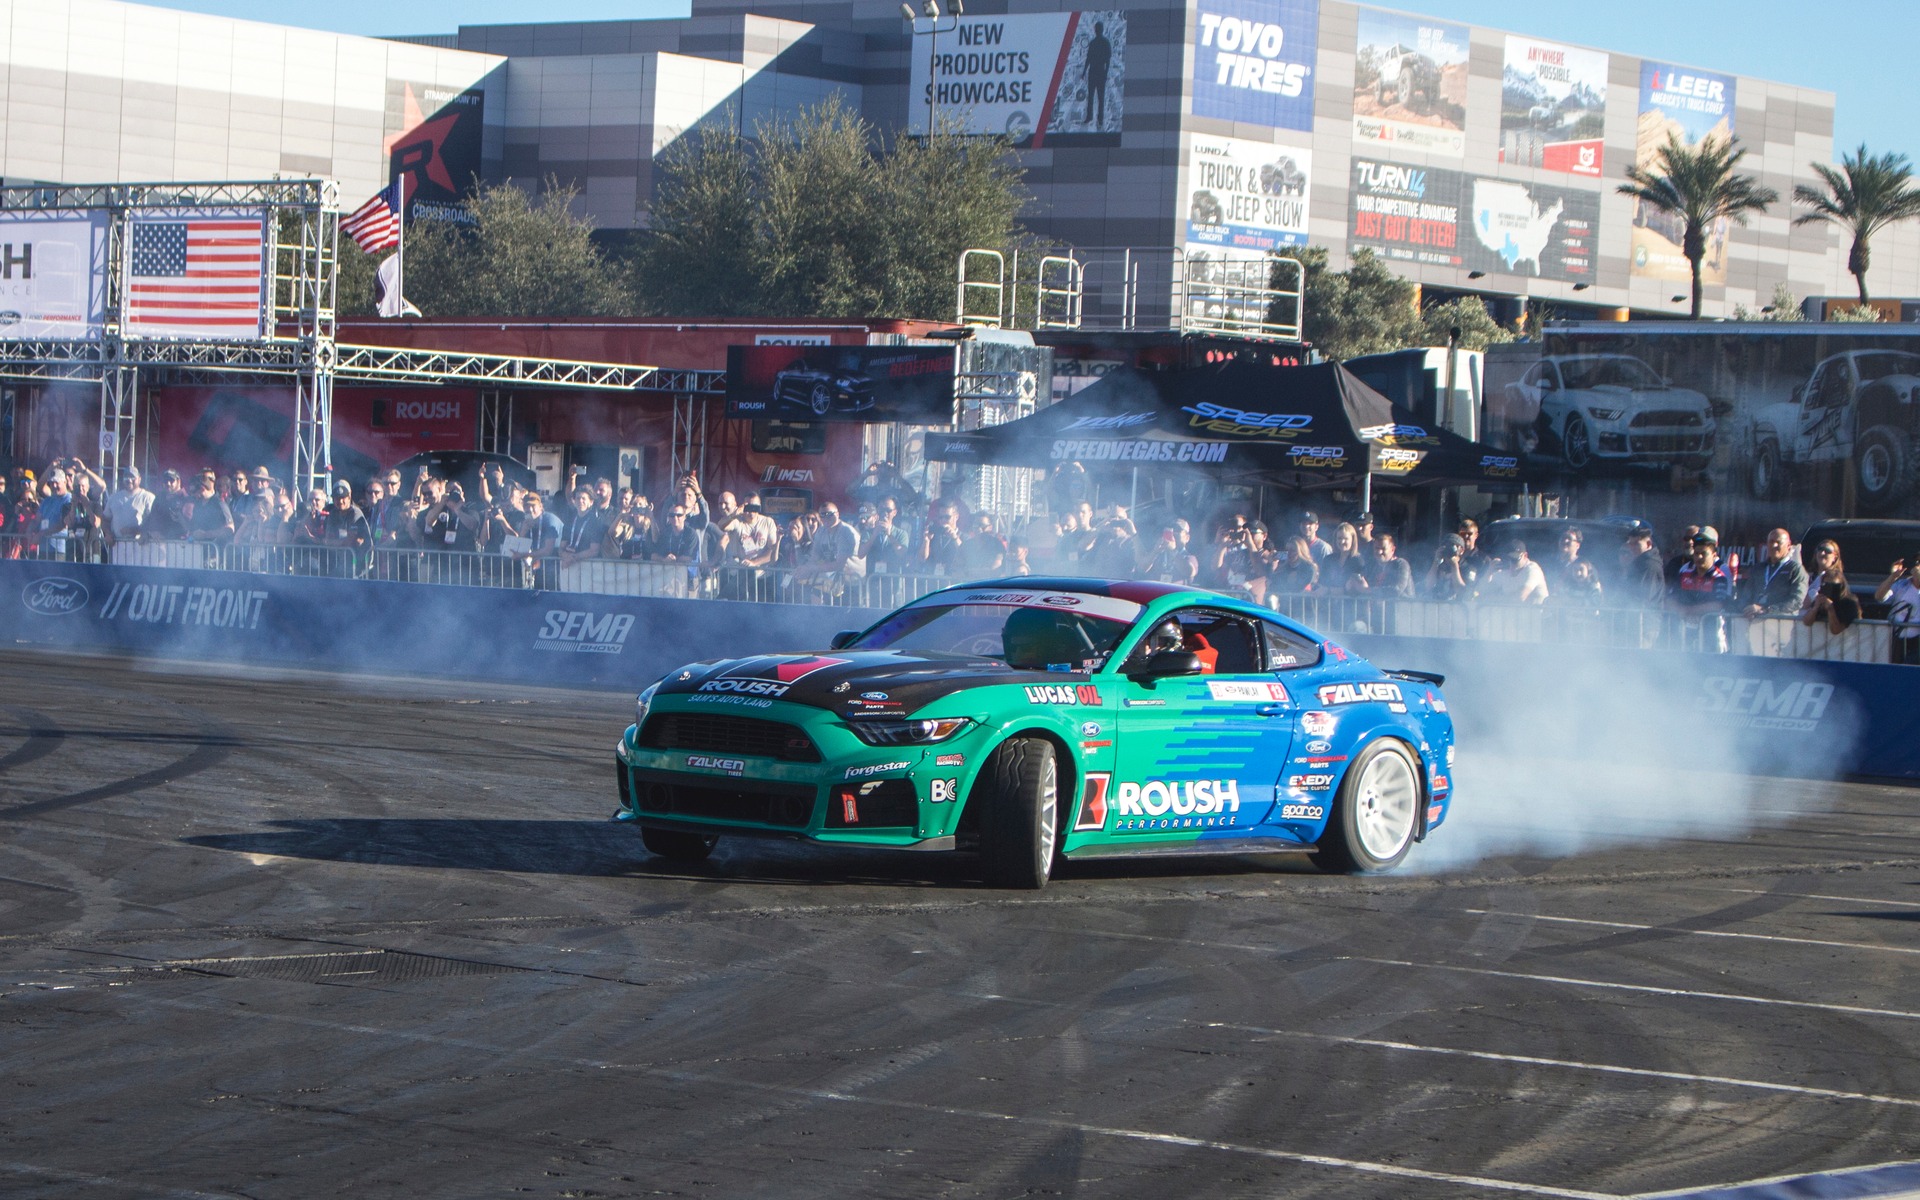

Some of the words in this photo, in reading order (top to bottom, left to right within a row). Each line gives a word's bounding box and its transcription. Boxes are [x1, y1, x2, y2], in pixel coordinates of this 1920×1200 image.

[958, 23, 1004, 46] NEW
[1200, 13, 1284, 59] TOYO
[930, 52, 1030, 76] PRODUCTS
[1528, 46, 1565, 66] ANYWHERE
[1216, 52, 1306, 98] TIRES
[925, 81, 1032, 105] SHOWCASE
[1665, 73, 1725, 102] LEER
[1195, 145, 1221, 155] LUND
[1199, 161, 1243, 192] TRUCK
[1248, 168, 1259, 195] &
[1226, 195, 1260, 222] JEEP
[1264, 199, 1303, 228] SHOW
[1357, 194, 1376, 212] YOUR
[1375, 197, 1419, 217] COMPETITIVE
[1420, 203, 1457, 223] ADVANTAGE
[1355, 211, 1383, 238] JUST
[1385, 214, 1408, 241] GOT
[1409, 218, 1457, 249] BETTER!
[42, 314, 82, 322] PERFORMANCE
[395, 401, 461, 419] ROUSH
[739, 401, 766, 411] ROUSH
[1181, 401, 1314, 428] SPEED
[1188, 413, 1315, 438] VEGAS
[1359, 423, 1428, 439] SPEED
[1371, 434, 1440, 446] VEGAS
[1050, 440, 1229, 462] SPEEDVEGAS.COM
[1286, 446, 1344, 458] SPEED
[1377, 447, 1419, 460] SPEED
[1292, 456, 1349, 468] VEGAS
[1380, 459, 1421, 471] VEGAS
[1480, 455, 1518, 468] SPEED
[1483, 465, 1520, 477] VEGAS
[777, 468, 815, 482] IMSA
[31, 582, 78, 610] Ford
[181, 587, 268, 629] FRONT
[538, 609, 636, 643] SEMA
[698, 680, 790, 697] ROUSH
[1023, 685, 1077, 706] LUCAS
[1075, 685, 1103, 707] OIL
[1269, 684, 1286, 700] 13
[1318, 682, 1403, 707] FALKEN
[1698, 676, 1836, 719] SEMA
[688, 694, 719, 703] SAM'S
[717, 694, 743, 705] AUTO
[743, 698, 773, 708] LAND
[1753, 719, 1813, 730] SHOW
[686, 756, 745, 771] FALKEN
[843, 760, 912, 780] forgestar
[1289, 774, 1335, 786] EXEDY
[1118, 780, 1240, 816] ROUSH
[1282, 804, 1324, 819] sparco
[1115, 816, 1238, 830] PERFORMANCE
